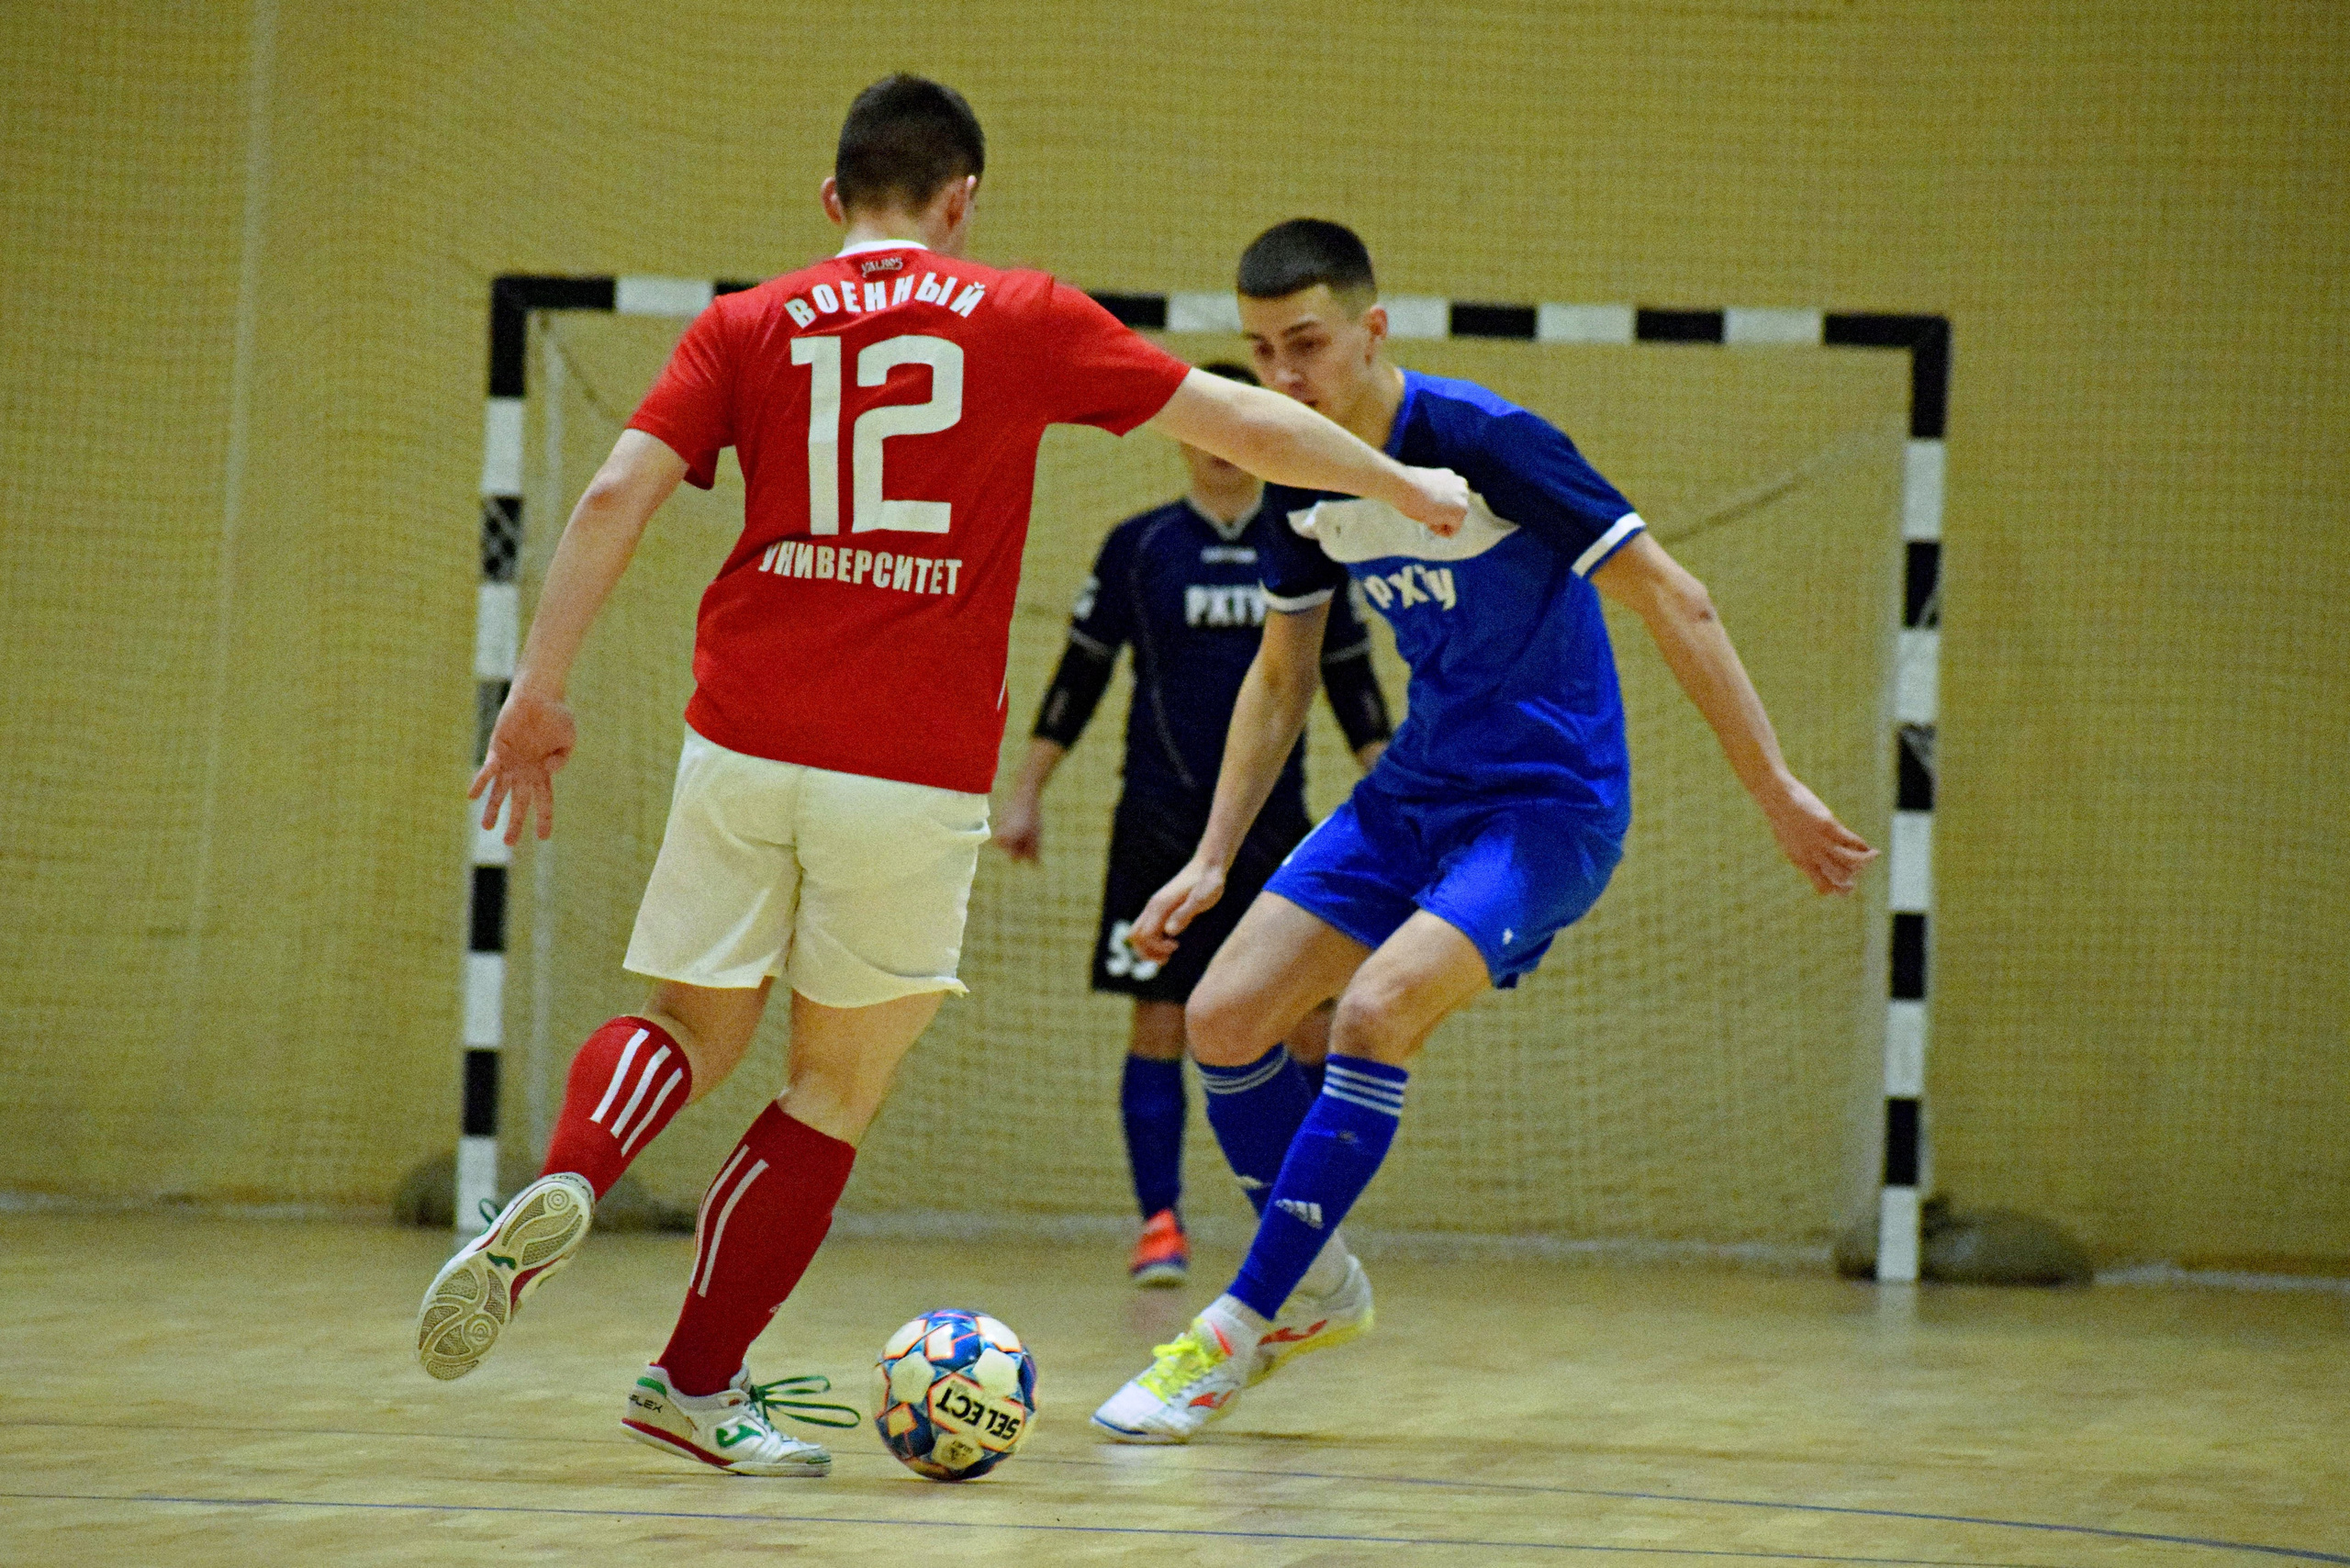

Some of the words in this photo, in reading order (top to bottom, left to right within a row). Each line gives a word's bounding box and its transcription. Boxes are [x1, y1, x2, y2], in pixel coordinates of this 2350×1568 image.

[784, 272, 986, 329] ВОЕННЫЙ
[790, 334, 964, 535] 12
[758, 541, 962, 595] УНИВЕРСИТЕТ
[935, 1387, 1020, 1441] SELECT
